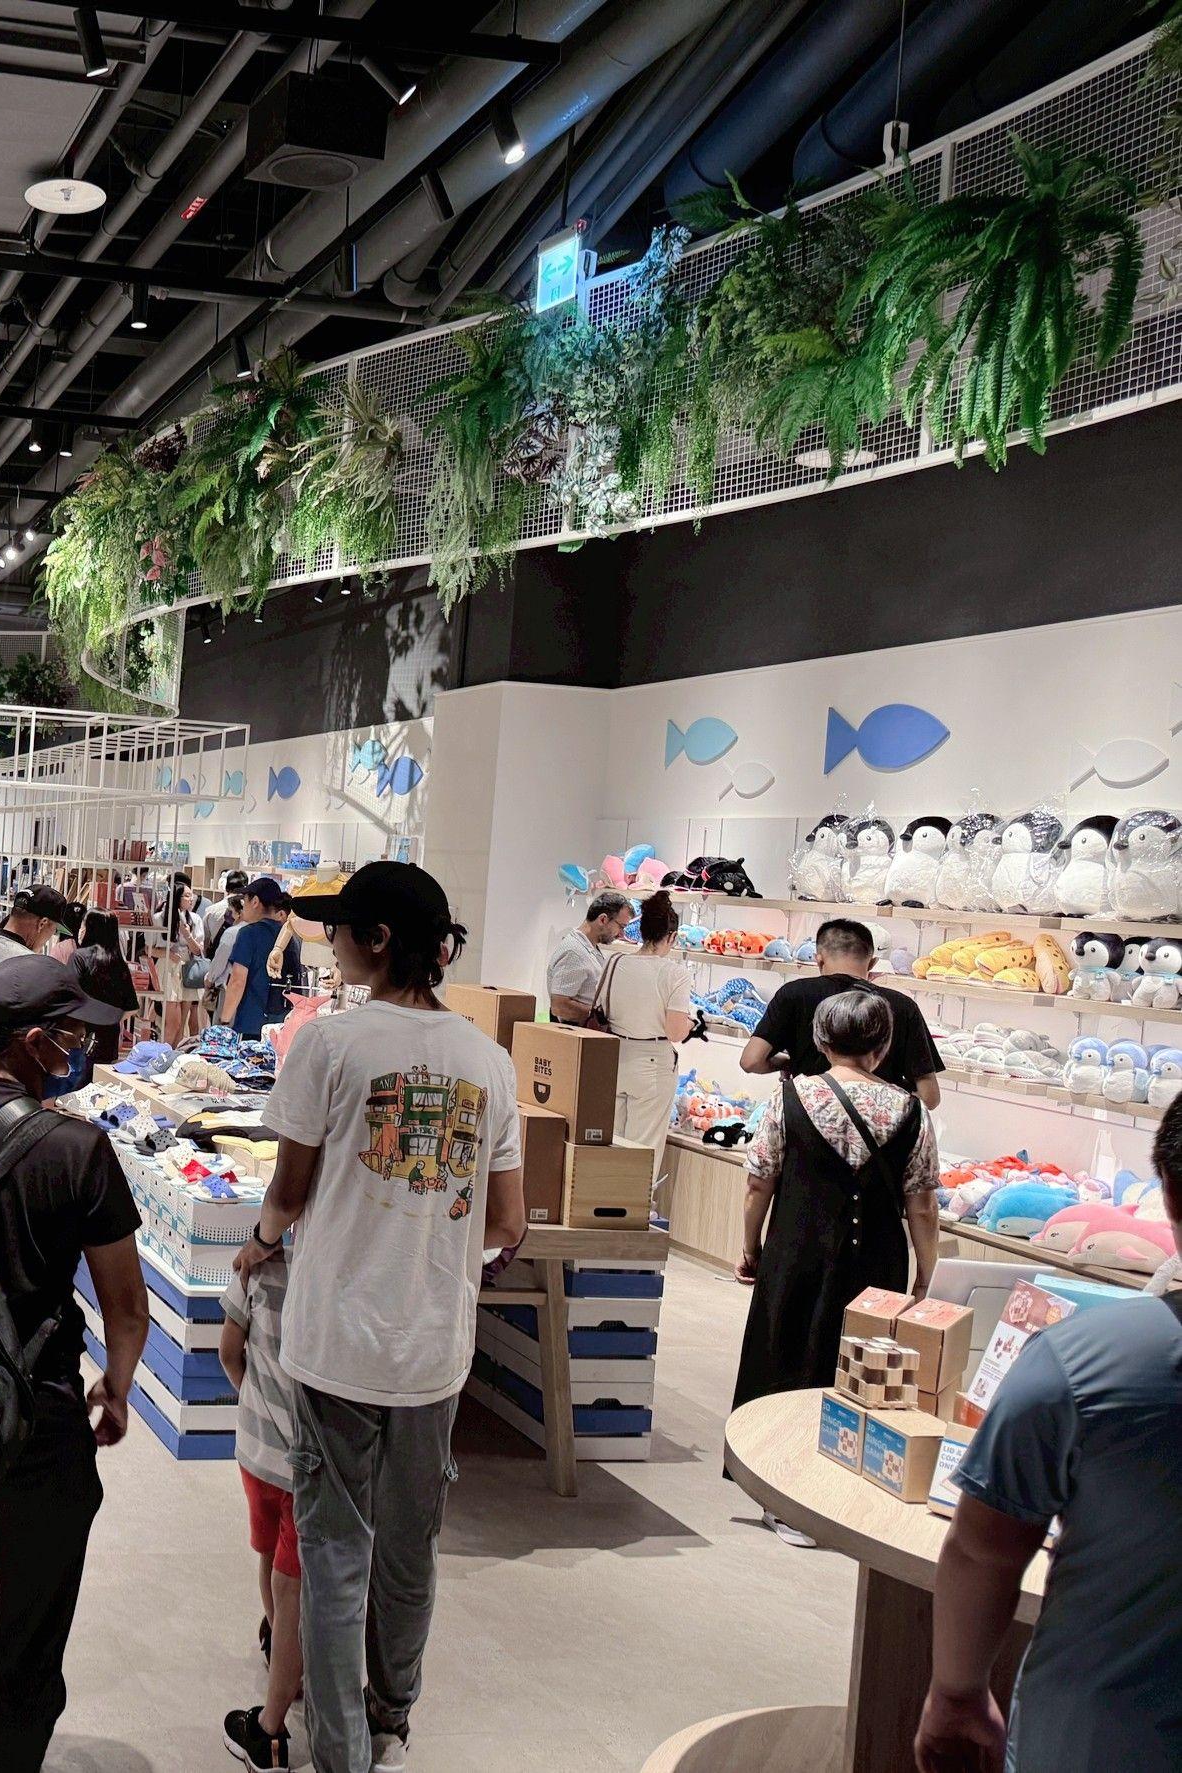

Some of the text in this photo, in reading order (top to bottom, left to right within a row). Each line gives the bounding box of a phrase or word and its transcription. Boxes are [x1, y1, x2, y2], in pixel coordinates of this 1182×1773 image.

[534, 1056, 552, 1067] BABY
[534, 1064, 553, 1076] BITES
[943, 1445, 955, 1454] LID
